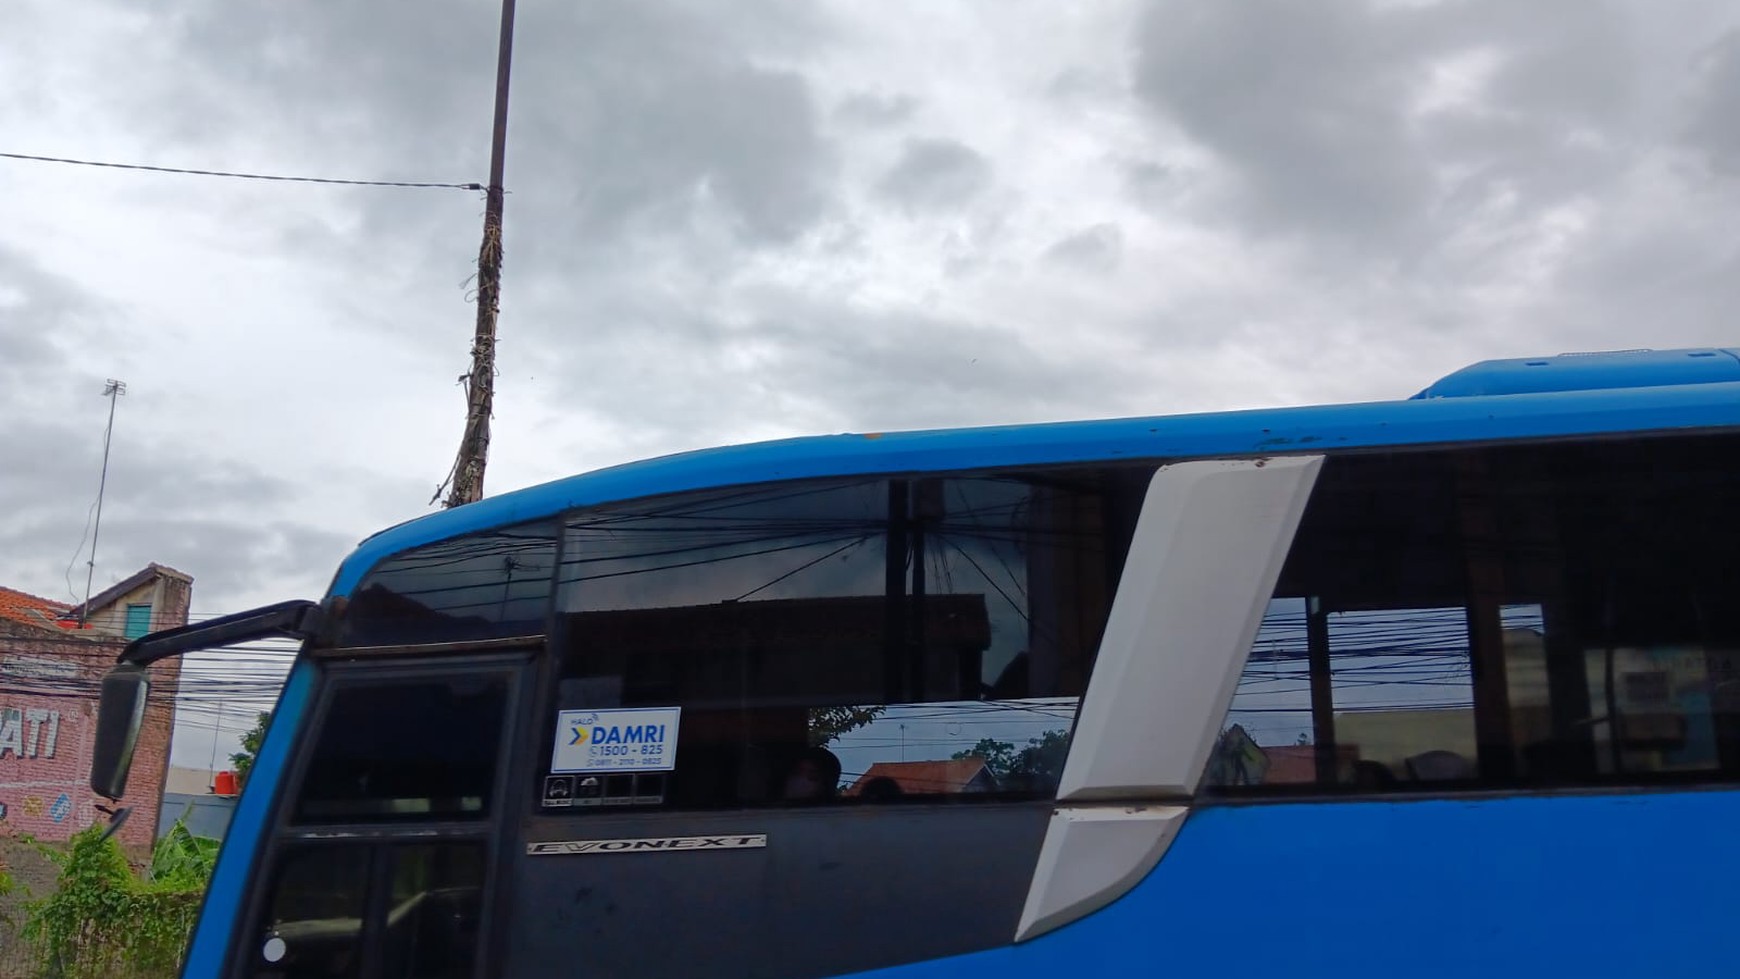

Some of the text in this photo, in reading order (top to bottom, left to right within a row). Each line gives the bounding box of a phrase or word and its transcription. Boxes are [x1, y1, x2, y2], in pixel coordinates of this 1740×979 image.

[0, 707, 59, 758] ATI
[591, 724, 665, 744] DAMRI
[600, 746, 628, 756] 1500
[641, 745, 663, 754] 825
[531, 837, 762, 852] EVONEXT
